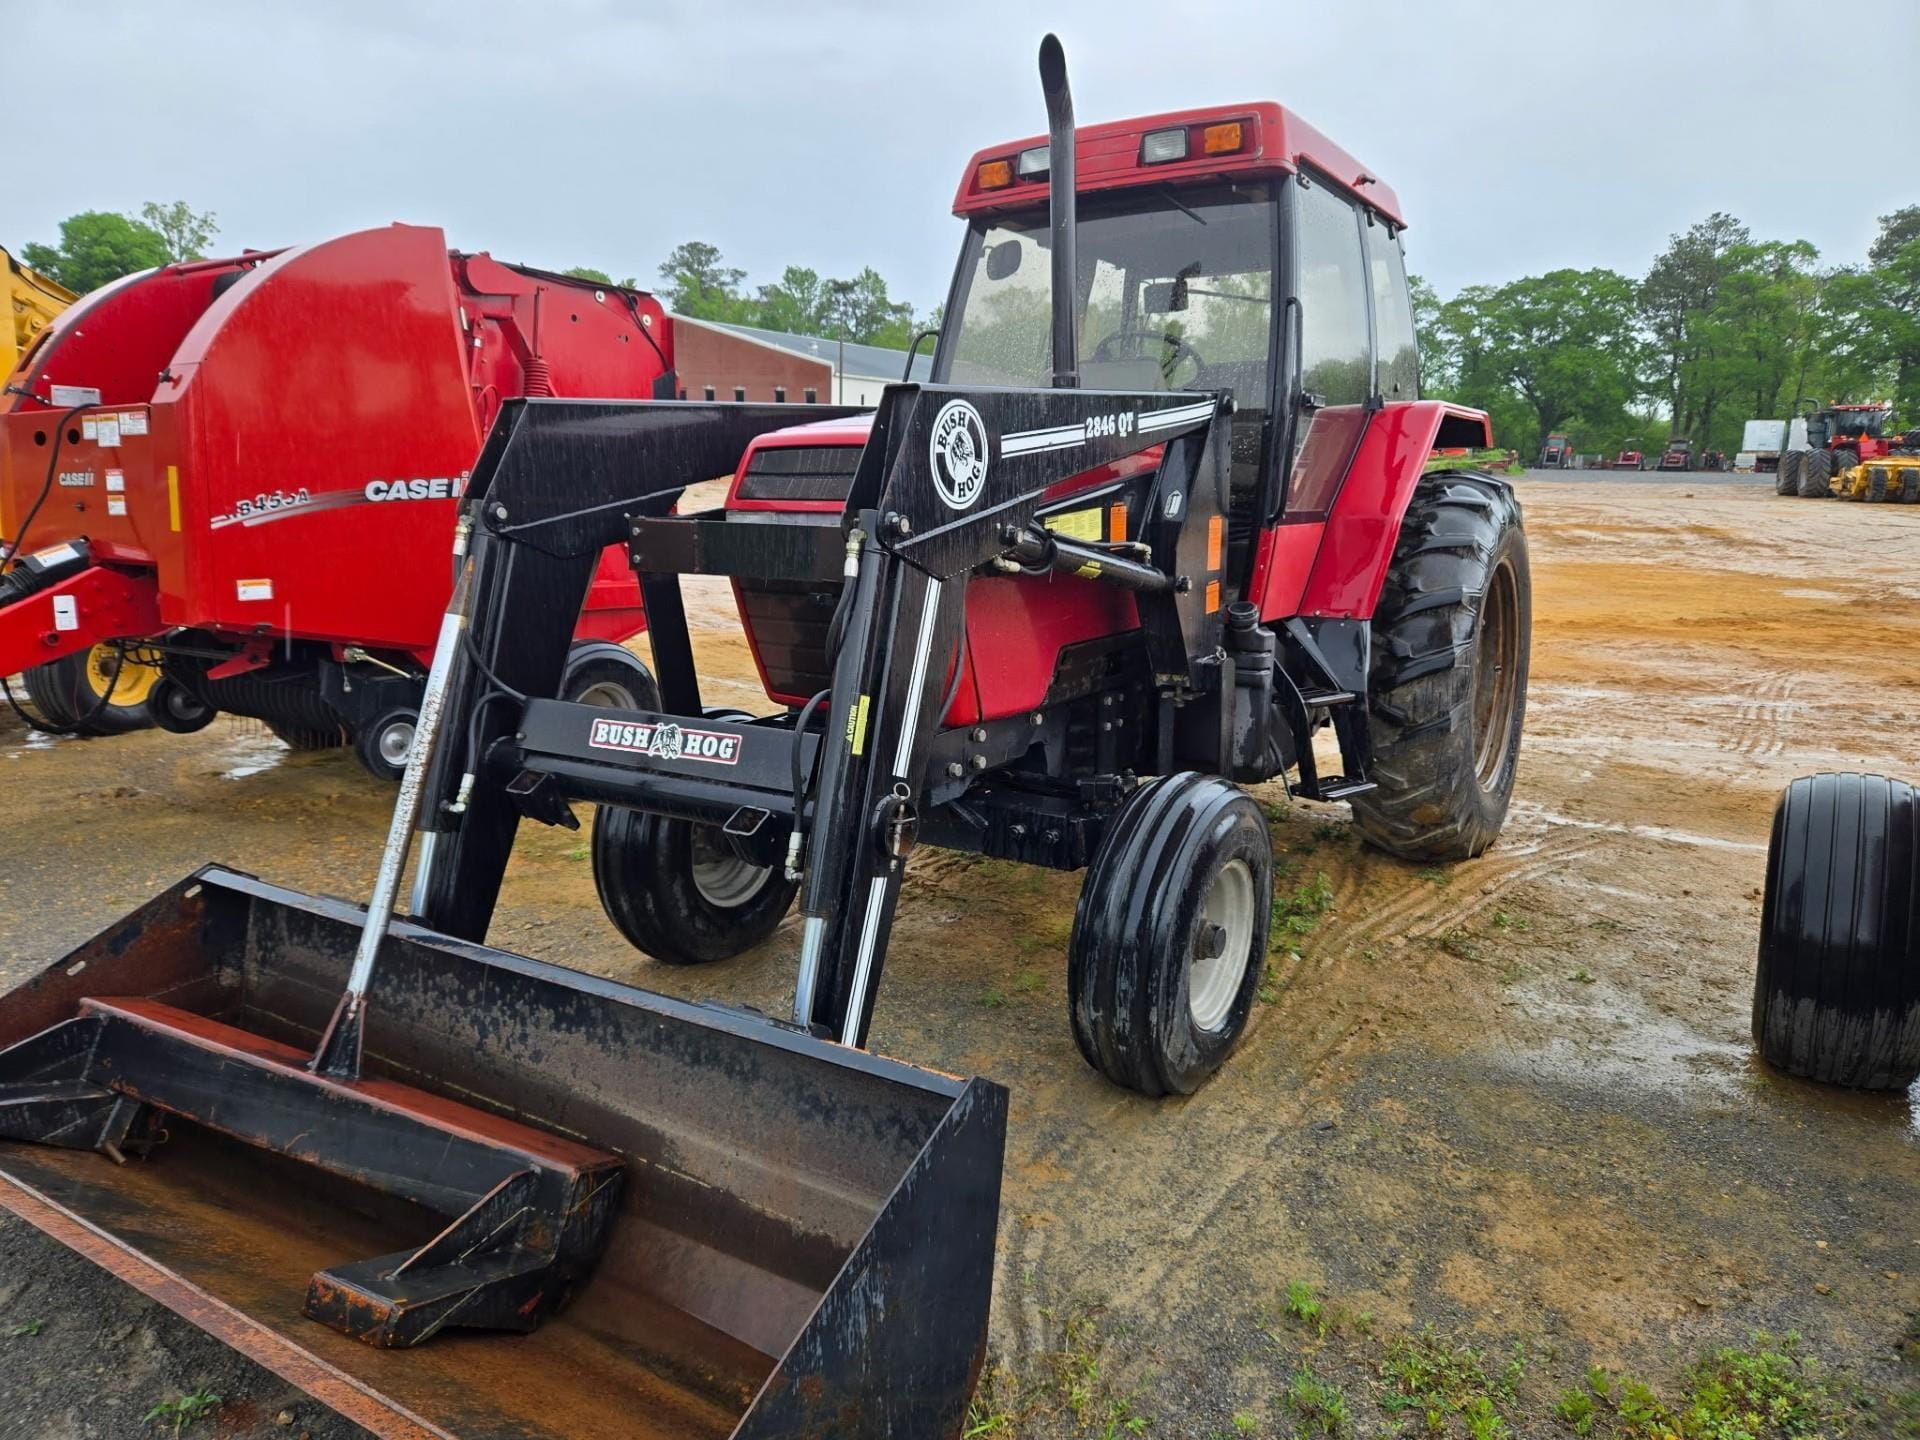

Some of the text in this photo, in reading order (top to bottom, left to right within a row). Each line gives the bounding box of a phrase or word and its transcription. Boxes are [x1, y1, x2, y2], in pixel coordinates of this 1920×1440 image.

[937, 411, 967, 450] BUSH
[1085, 411, 1134, 439] 2846 QT
[59, 472, 84, 486] CASE
[365, 478, 448, 501] CASE
[957, 465, 981, 498] HOG
[594, 723, 737, 759] BUSH HOG
